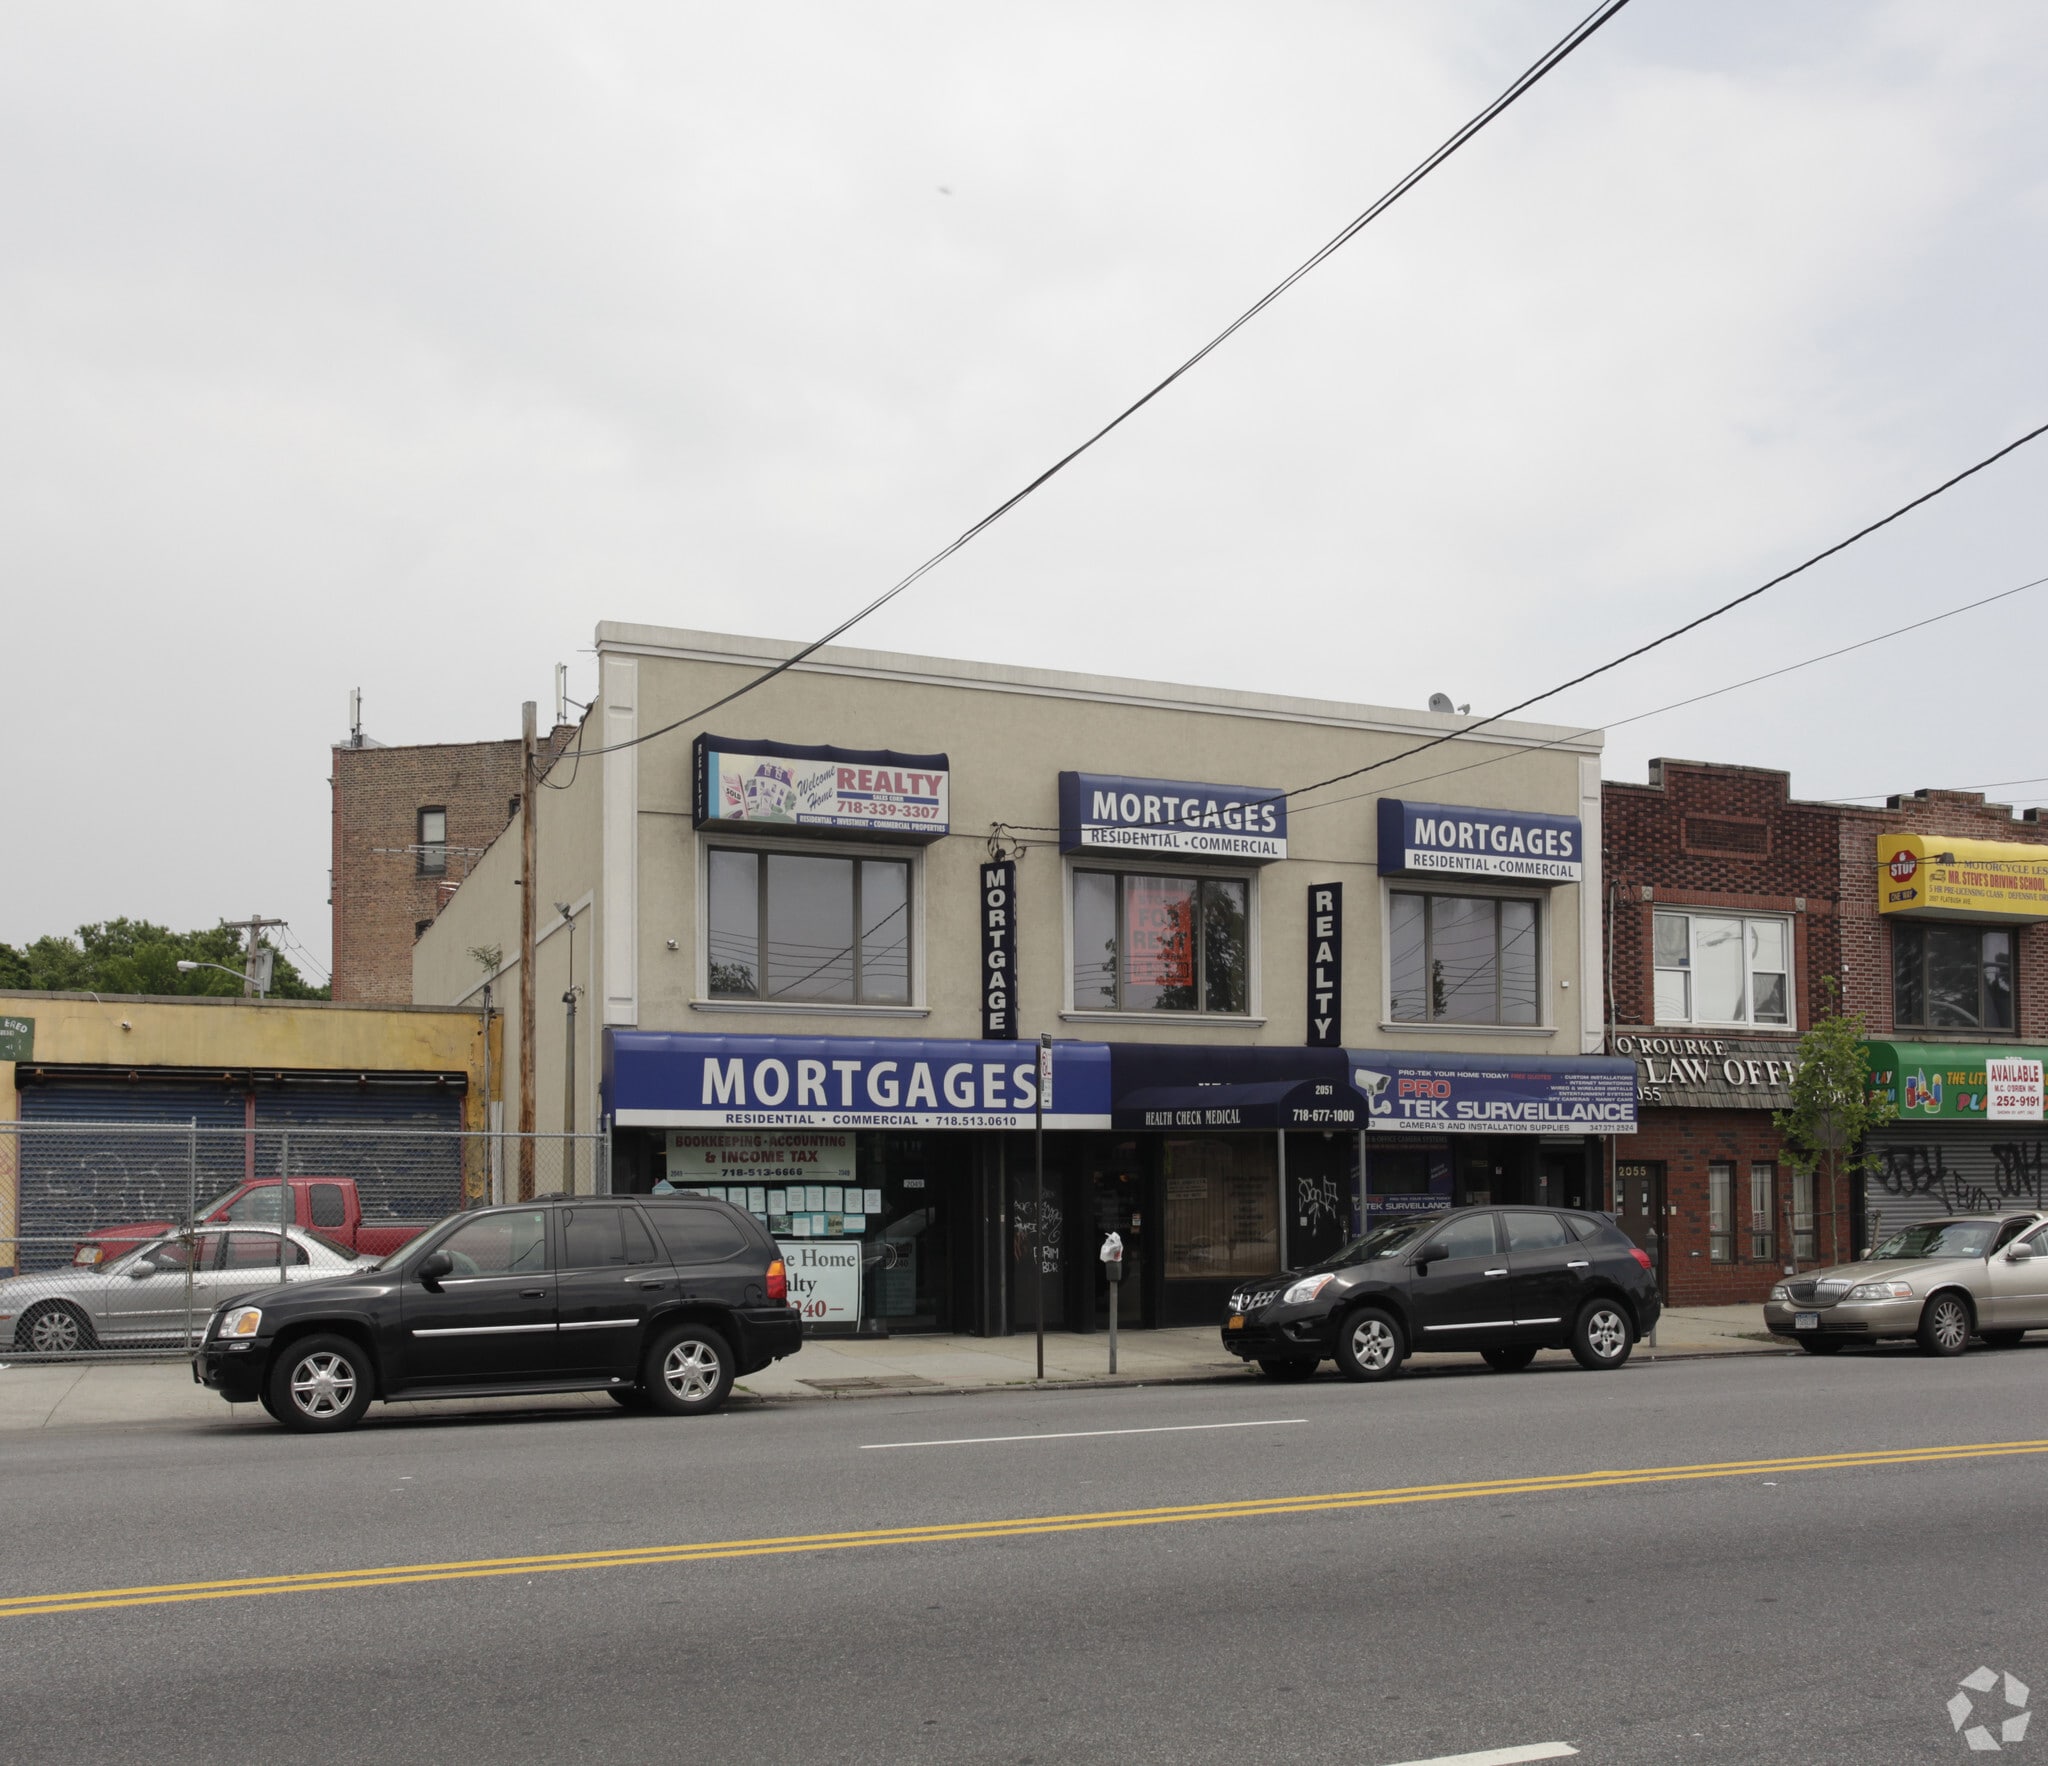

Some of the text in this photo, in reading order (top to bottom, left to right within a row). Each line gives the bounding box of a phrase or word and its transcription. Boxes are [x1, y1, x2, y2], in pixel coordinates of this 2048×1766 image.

[797, 766, 836, 797] Welcome
[836, 767, 943, 796] REALTY
[726, 787, 741, 800] SOLD
[807, 788, 833, 811] Home
[837, 800, 940, 819] 718-339-3307
[1092, 791, 1277, 833] MORTGAGES
[800, 815, 946, 833] RESIDENTIAL INVESTMENT COMMERCIAL PROPERTIES
[1091, 829, 1278, 855] RESIDENTIAL COMMERCIAL
[1414, 818, 1573, 857] MORTGAGES
[1413, 854, 1574, 878] RESIDENTIAL COMMERCIAL
[1891, 861, 1915, 876] STOP
[1964, 861, 2029, 874] MOTORCYCLE
[1948, 870, 1961, 885] MR.
[1962, 871, 1989, 887] STEVE'S
[1989, 874, 2018, 889] DRIVING
[986, 868, 1006, 1030] MORTGAGE
[1314, 890, 1334, 1040] REALTY
[1616, 1035, 1727, 1056] O'ROURKE
[1642, 1058, 1710, 1085] LAW
[1723, 1059, 1806, 1086] OFFI
[1870, 1070, 1892, 1084] PLAY
[1947, 1071, 1966, 1085] THE
[1991, 1064, 2039, 1082] AVAILABLE
[701, 1057, 1037, 1110] MORTGAGES
[1315, 1085, 1333, 1095] 2051
[1398, 1078, 1451, 1098] PRO
[1996, 1095, 2039, 1107] 252-9191
[1145, 1109, 1241, 1126] HEALTH CHECK MEDICAL
[1293, 1109, 1355, 1122] 718-677-1000
[1399, 1100, 1634, 1121] TEK SURVEILLANCE
[726, 1113, 1017, 1127] RESIDENTIAL COMMERCIAL 718.513.0610
[1400, 1121, 1445, 1130] CAMERA'S
[1448, 1122, 1466, 1130] AND
[1468, 1122, 1528, 1131] INSTALLATION
[1530, 1123, 1570, 1132] SUPPLIES
[675, 1135, 846, 1148] BOOKKEEPING ACCOUNTING
[705, 1151, 818, 1163] & INCOME TAX
[1618, 1166, 1647, 1176] 2055
[1385, 1202, 1451, 1210] SURVEILLANCE
[801, 1249, 856, 1267] Home
